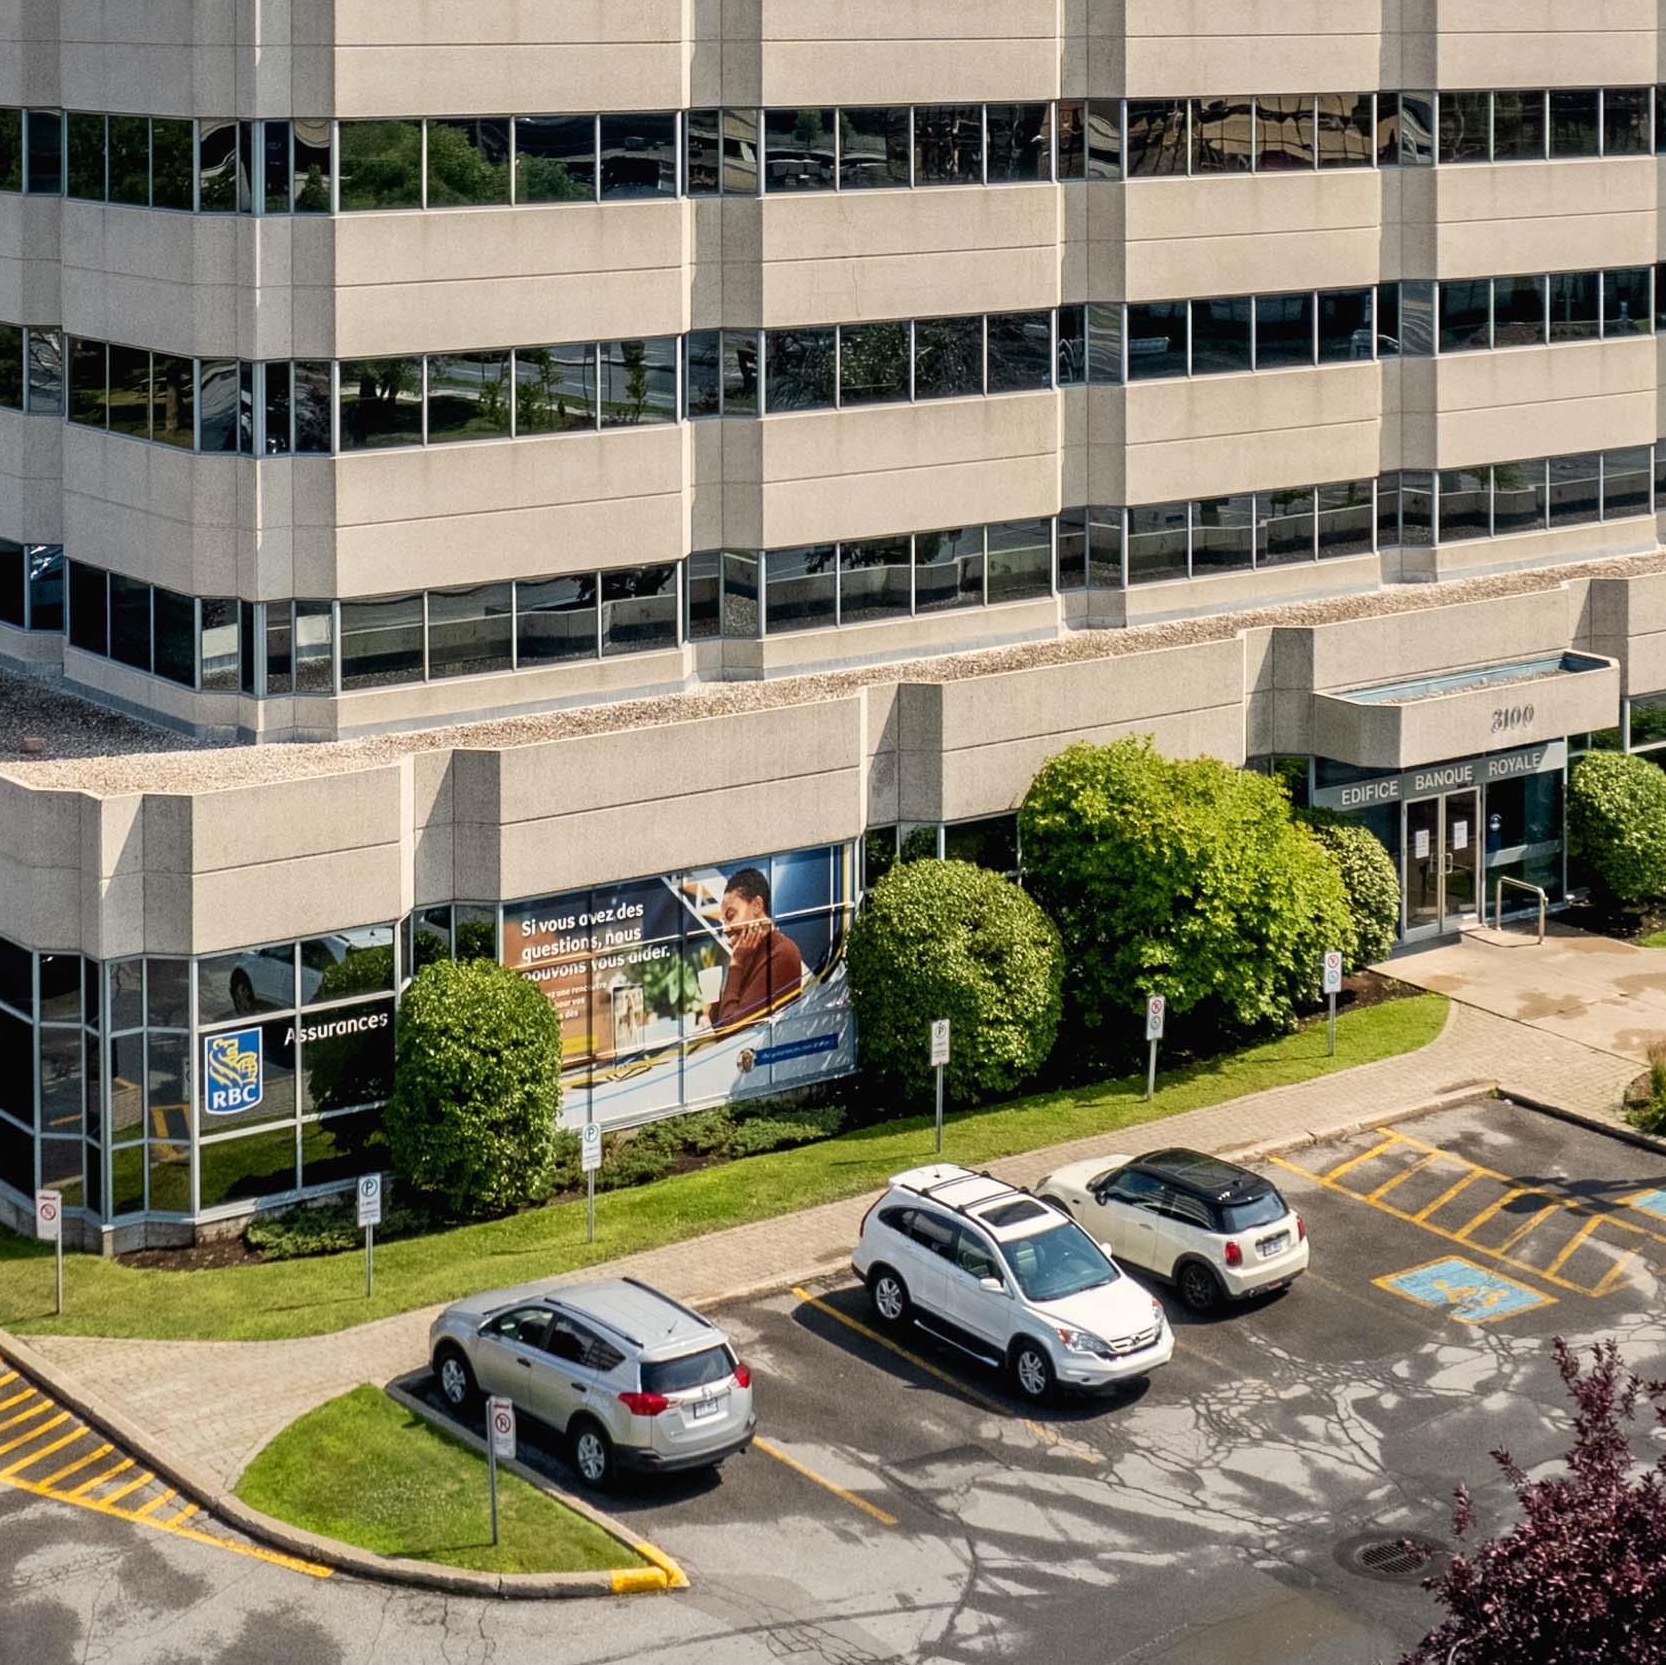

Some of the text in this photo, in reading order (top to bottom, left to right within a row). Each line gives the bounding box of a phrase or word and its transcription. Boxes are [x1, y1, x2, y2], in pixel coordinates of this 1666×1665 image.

[1491, 703, 1534, 733] 3100
[1341, 752, 1543, 805] EDIFICE BANQUE ROYALE
[521, 902, 644, 937] Si vous avez des
[521, 927, 642, 963] questions, nous
[591, 953, 625, 972] vous
[628, 944, 671, 964] aider.
[284, 1012, 388, 1046] Assurances
[213, 1083, 256, 1110] RBC
